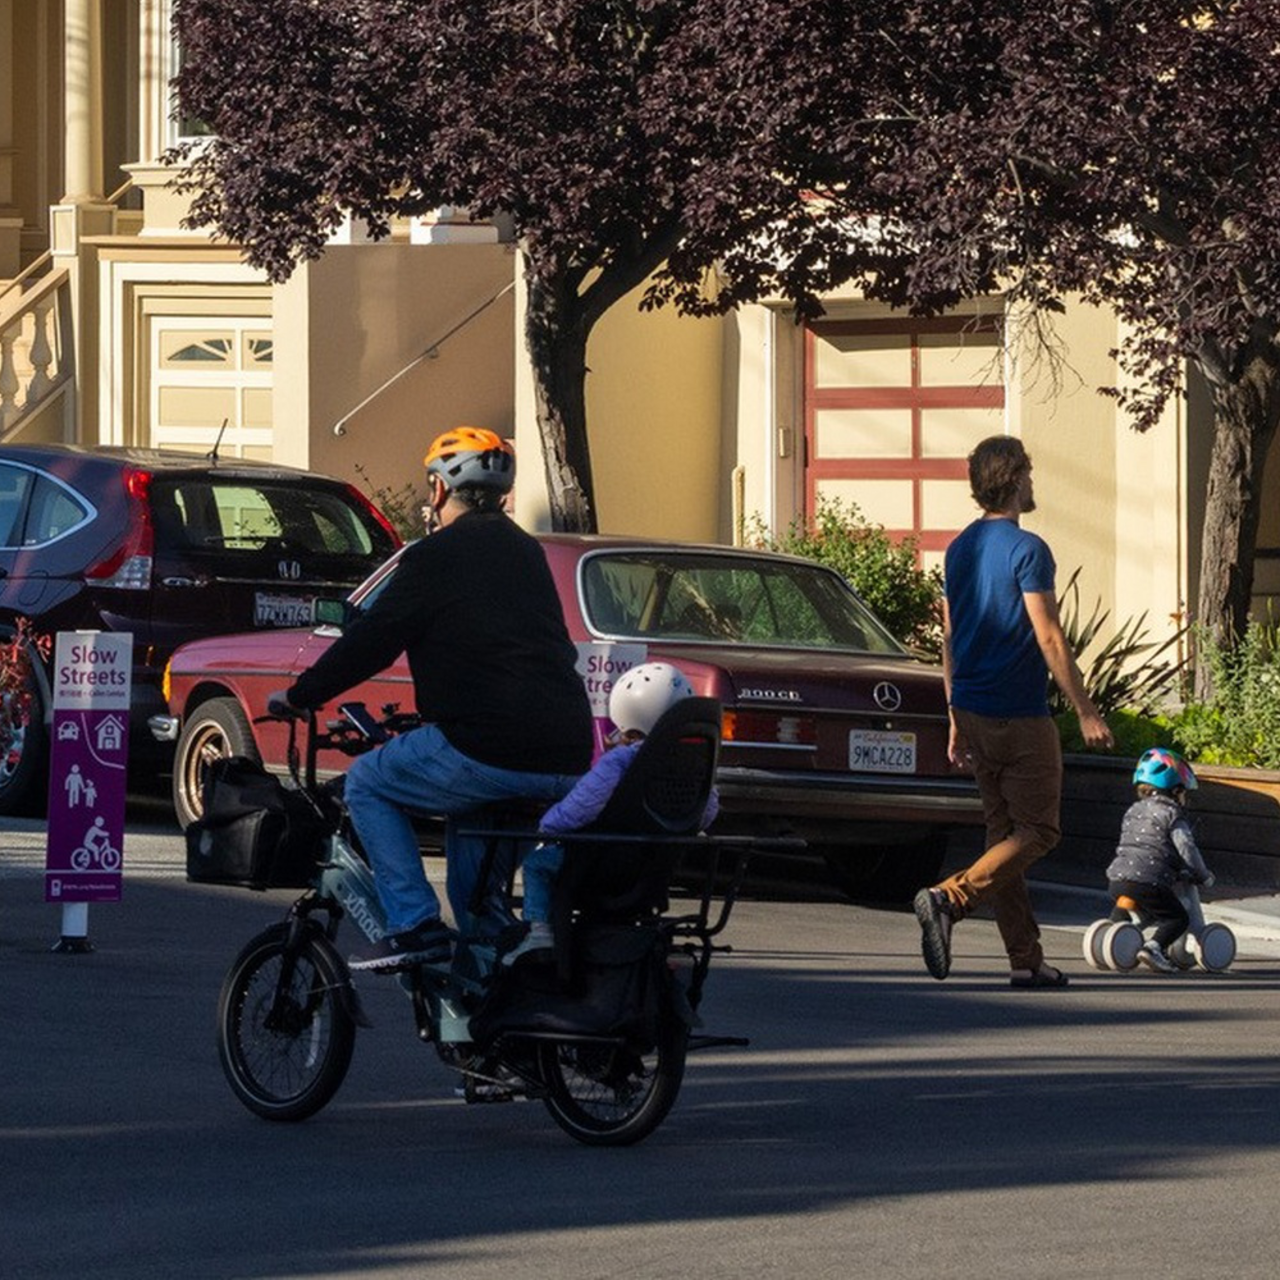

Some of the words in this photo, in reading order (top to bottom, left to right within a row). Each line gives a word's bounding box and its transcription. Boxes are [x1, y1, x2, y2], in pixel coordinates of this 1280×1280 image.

[71, 645, 118, 664] Slow
[587, 655, 632, 674] Slow
[60, 667, 126, 686] Streets
[853, 745, 913, 767] 9MCA228
[342, 891, 386, 945] xtrac
